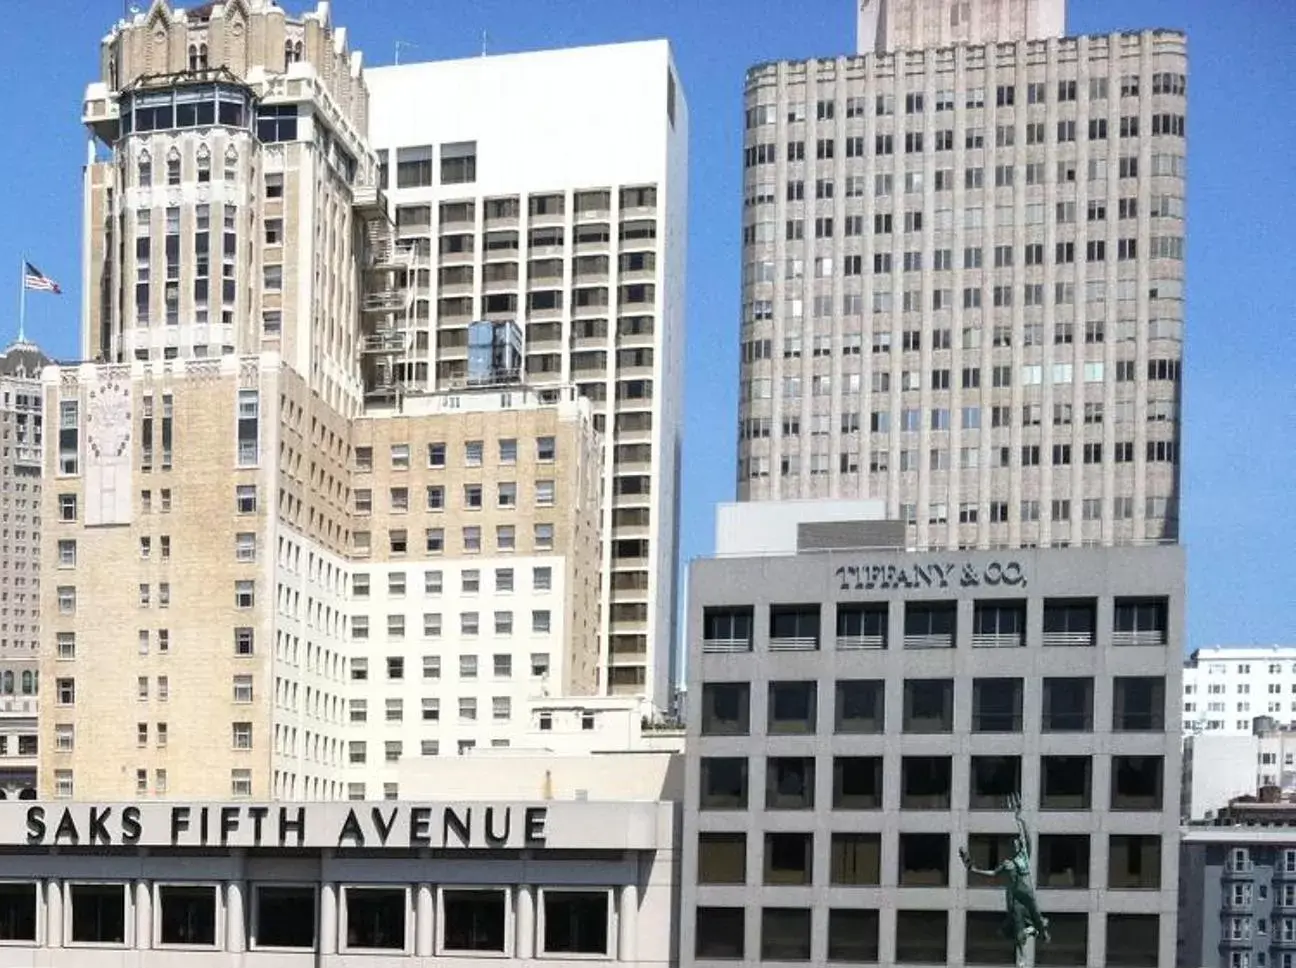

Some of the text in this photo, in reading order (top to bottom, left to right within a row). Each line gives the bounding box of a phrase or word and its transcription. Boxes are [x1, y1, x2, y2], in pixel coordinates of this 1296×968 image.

[835, 563, 956, 590] TIFFANY
[959, 562, 980, 588] &
[26, 806, 549, 848] SAKS FIFTH AVENUE
